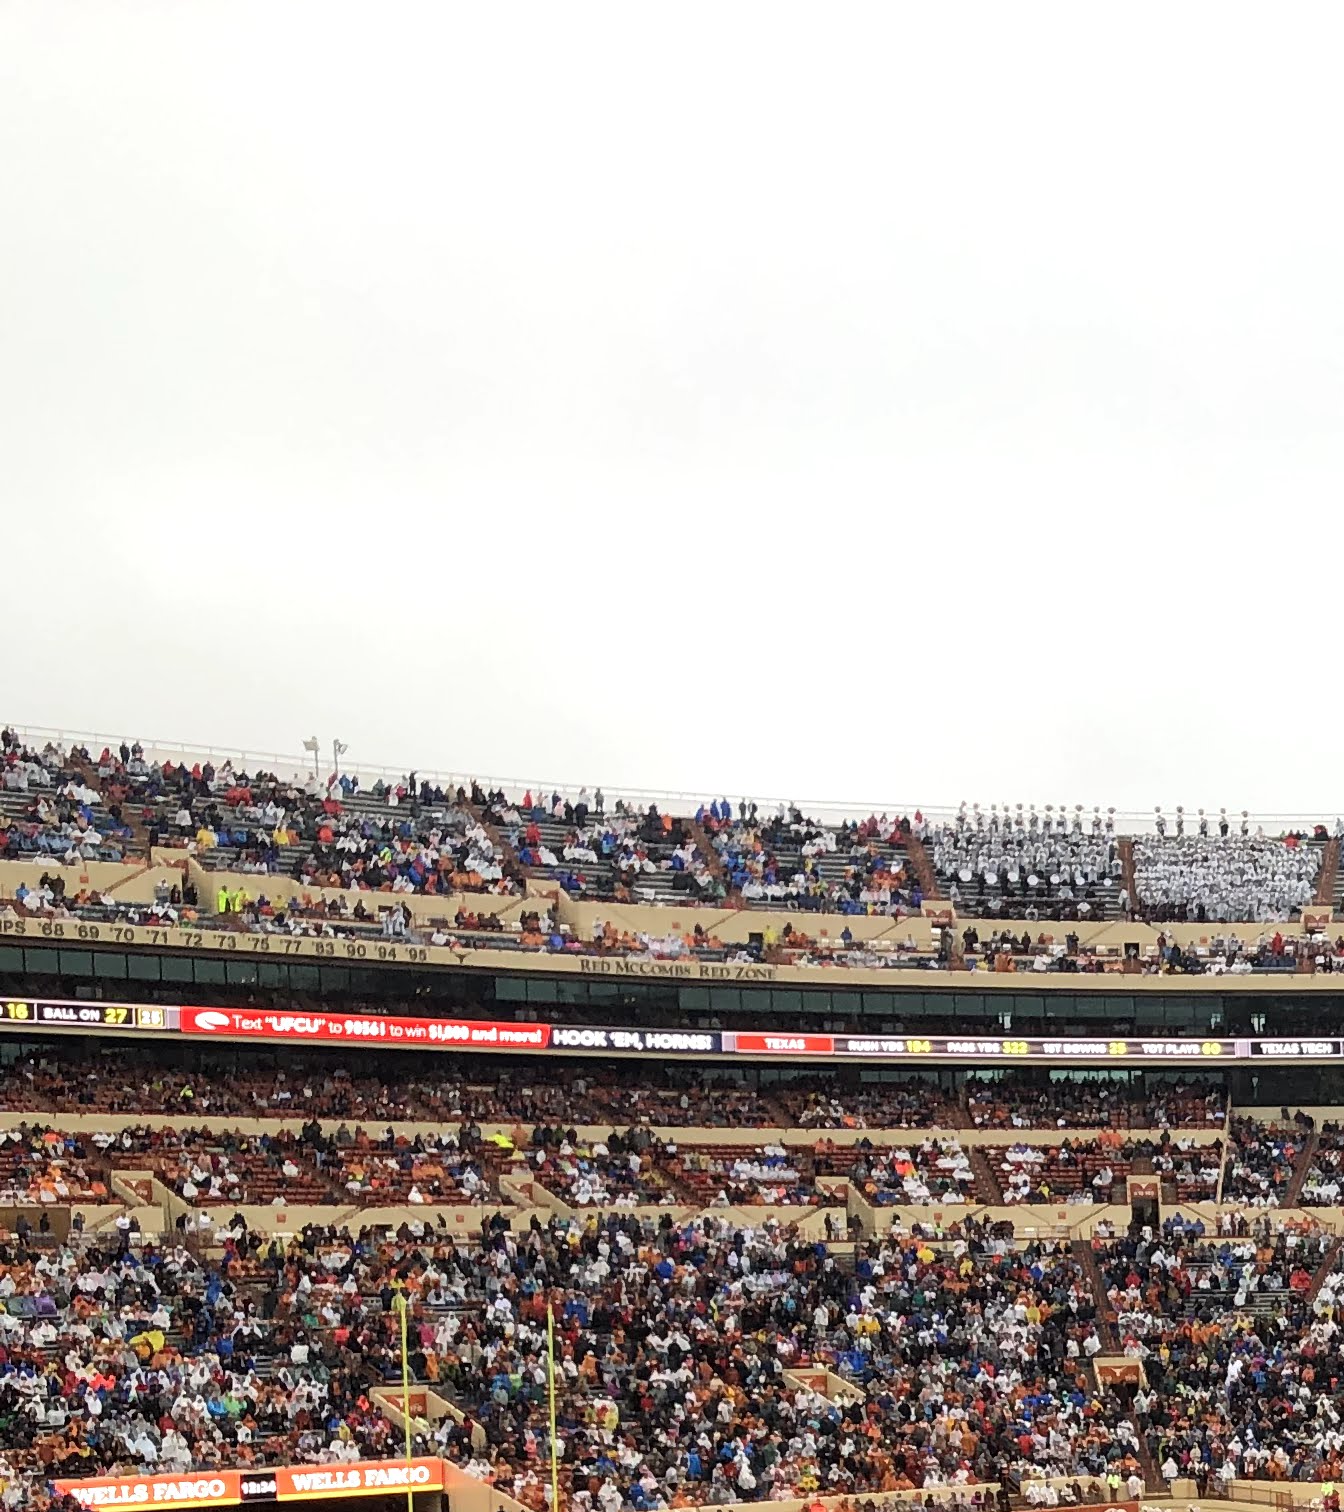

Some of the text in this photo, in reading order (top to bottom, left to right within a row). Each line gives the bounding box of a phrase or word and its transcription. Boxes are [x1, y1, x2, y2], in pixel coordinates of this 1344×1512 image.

[37, 921, 64, 936] '68
[74, 924, 100, 939] '69
[109, 927, 134, 943] '70
[146, 930, 168, 944] '71
[179, 932, 203, 947] '72
[213, 934, 236, 949] '73
[280, 938, 302, 952] '77
[343, 942, 366, 957] '90
[580, 959, 776, 979] RED RED ZONE
[7, 1003, 29, 1019] 16
[43, 1006, 128, 1024] BALL ON 27
[232, 1013, 262, 1030] Text
[328, 1021, 342, 1034] to
[389, 1024, 403, 1037] to
[405, 1025, 426, 1037] win
[471, 1026, 498, 1041] and
[553, 1029, 713, 1051] HOOK HORNS!
[764, 1037, 806, 1050] TEXAS
[1261, 1043, 1333, 1054] TEXAS TECH
[292, 1466, 430, 1491] WELLS FARGO
[70, 1479, 226, 1505] WELLS FARGO
